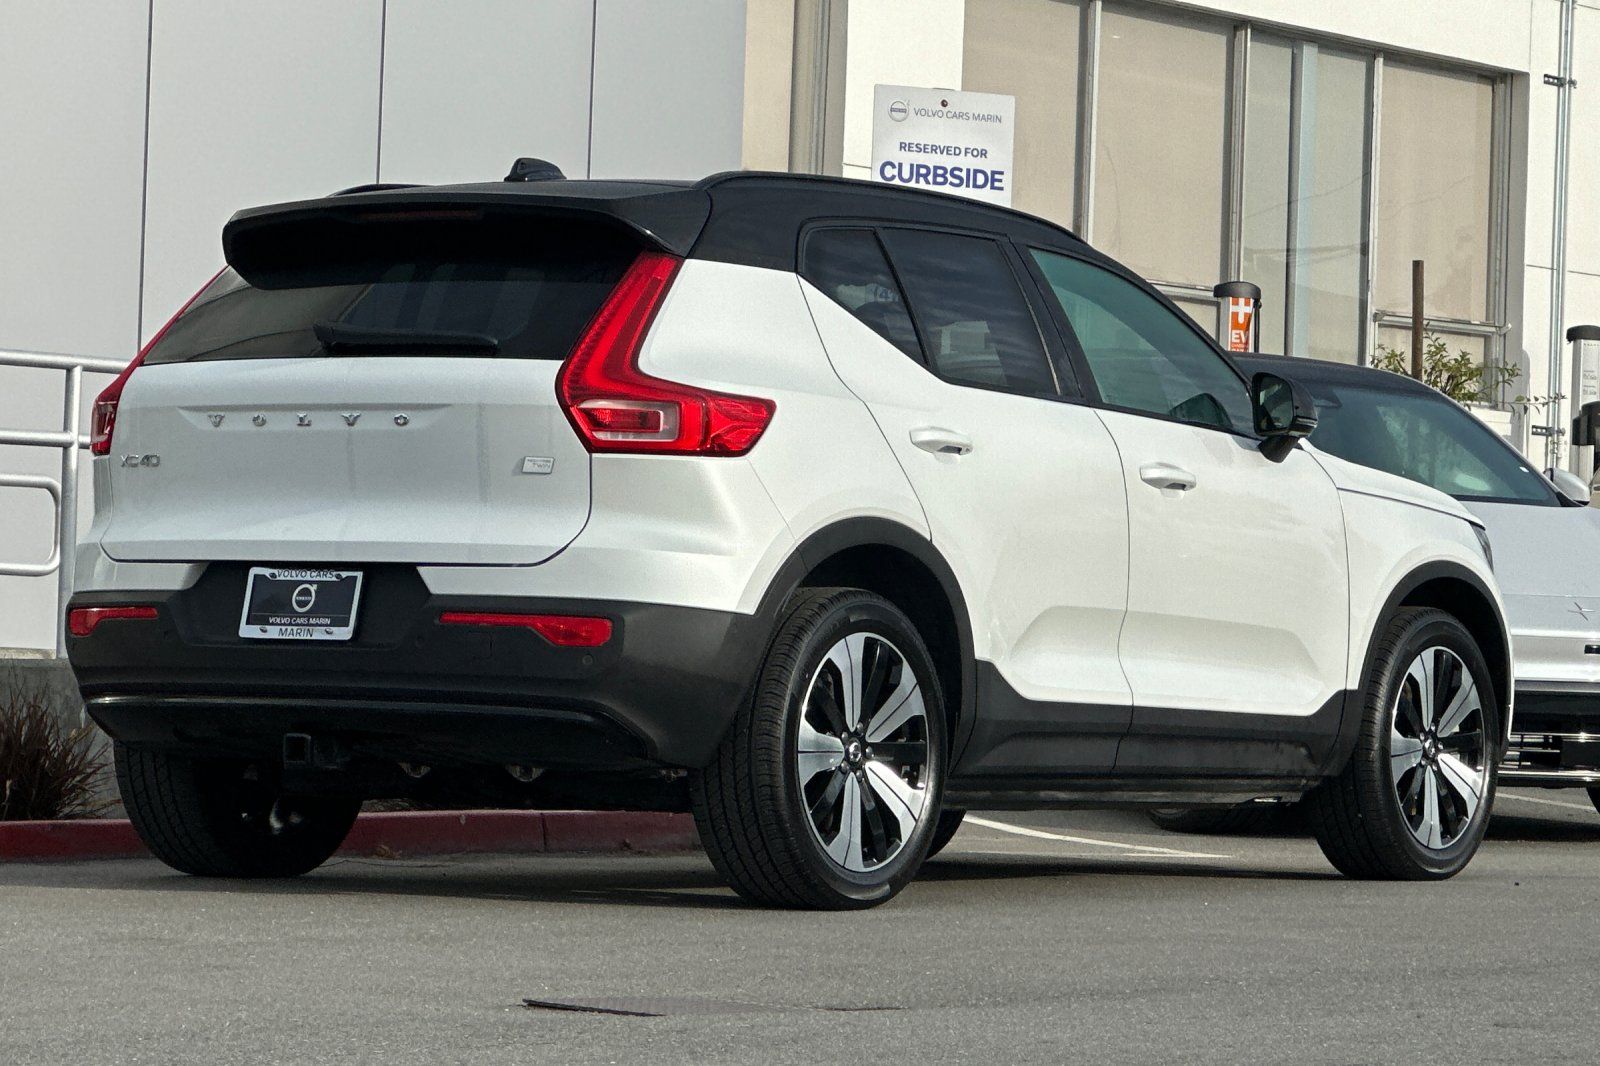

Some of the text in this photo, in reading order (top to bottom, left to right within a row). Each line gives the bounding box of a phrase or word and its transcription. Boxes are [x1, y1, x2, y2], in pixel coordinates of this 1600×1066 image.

[913, 107, 944, 119] VOLVO
[945, 110, 970, 121] CARS
[971, 112, 1002, 124] MARIN
[899, 141, 988, 159] RESERVED FOR
[879, 160, 1005, 191] CURBSIDE
[1231, 330, 1248, 343] EV
[208, 413, 409, 428] VOLVO
[120, 454, 161, 468] XC40
[277, 568, 335, 579] VOLVO CARS
[268, 616, 331, 625] VOLVO CARS MARIN
[277, 627, 314, 638] MARIN
